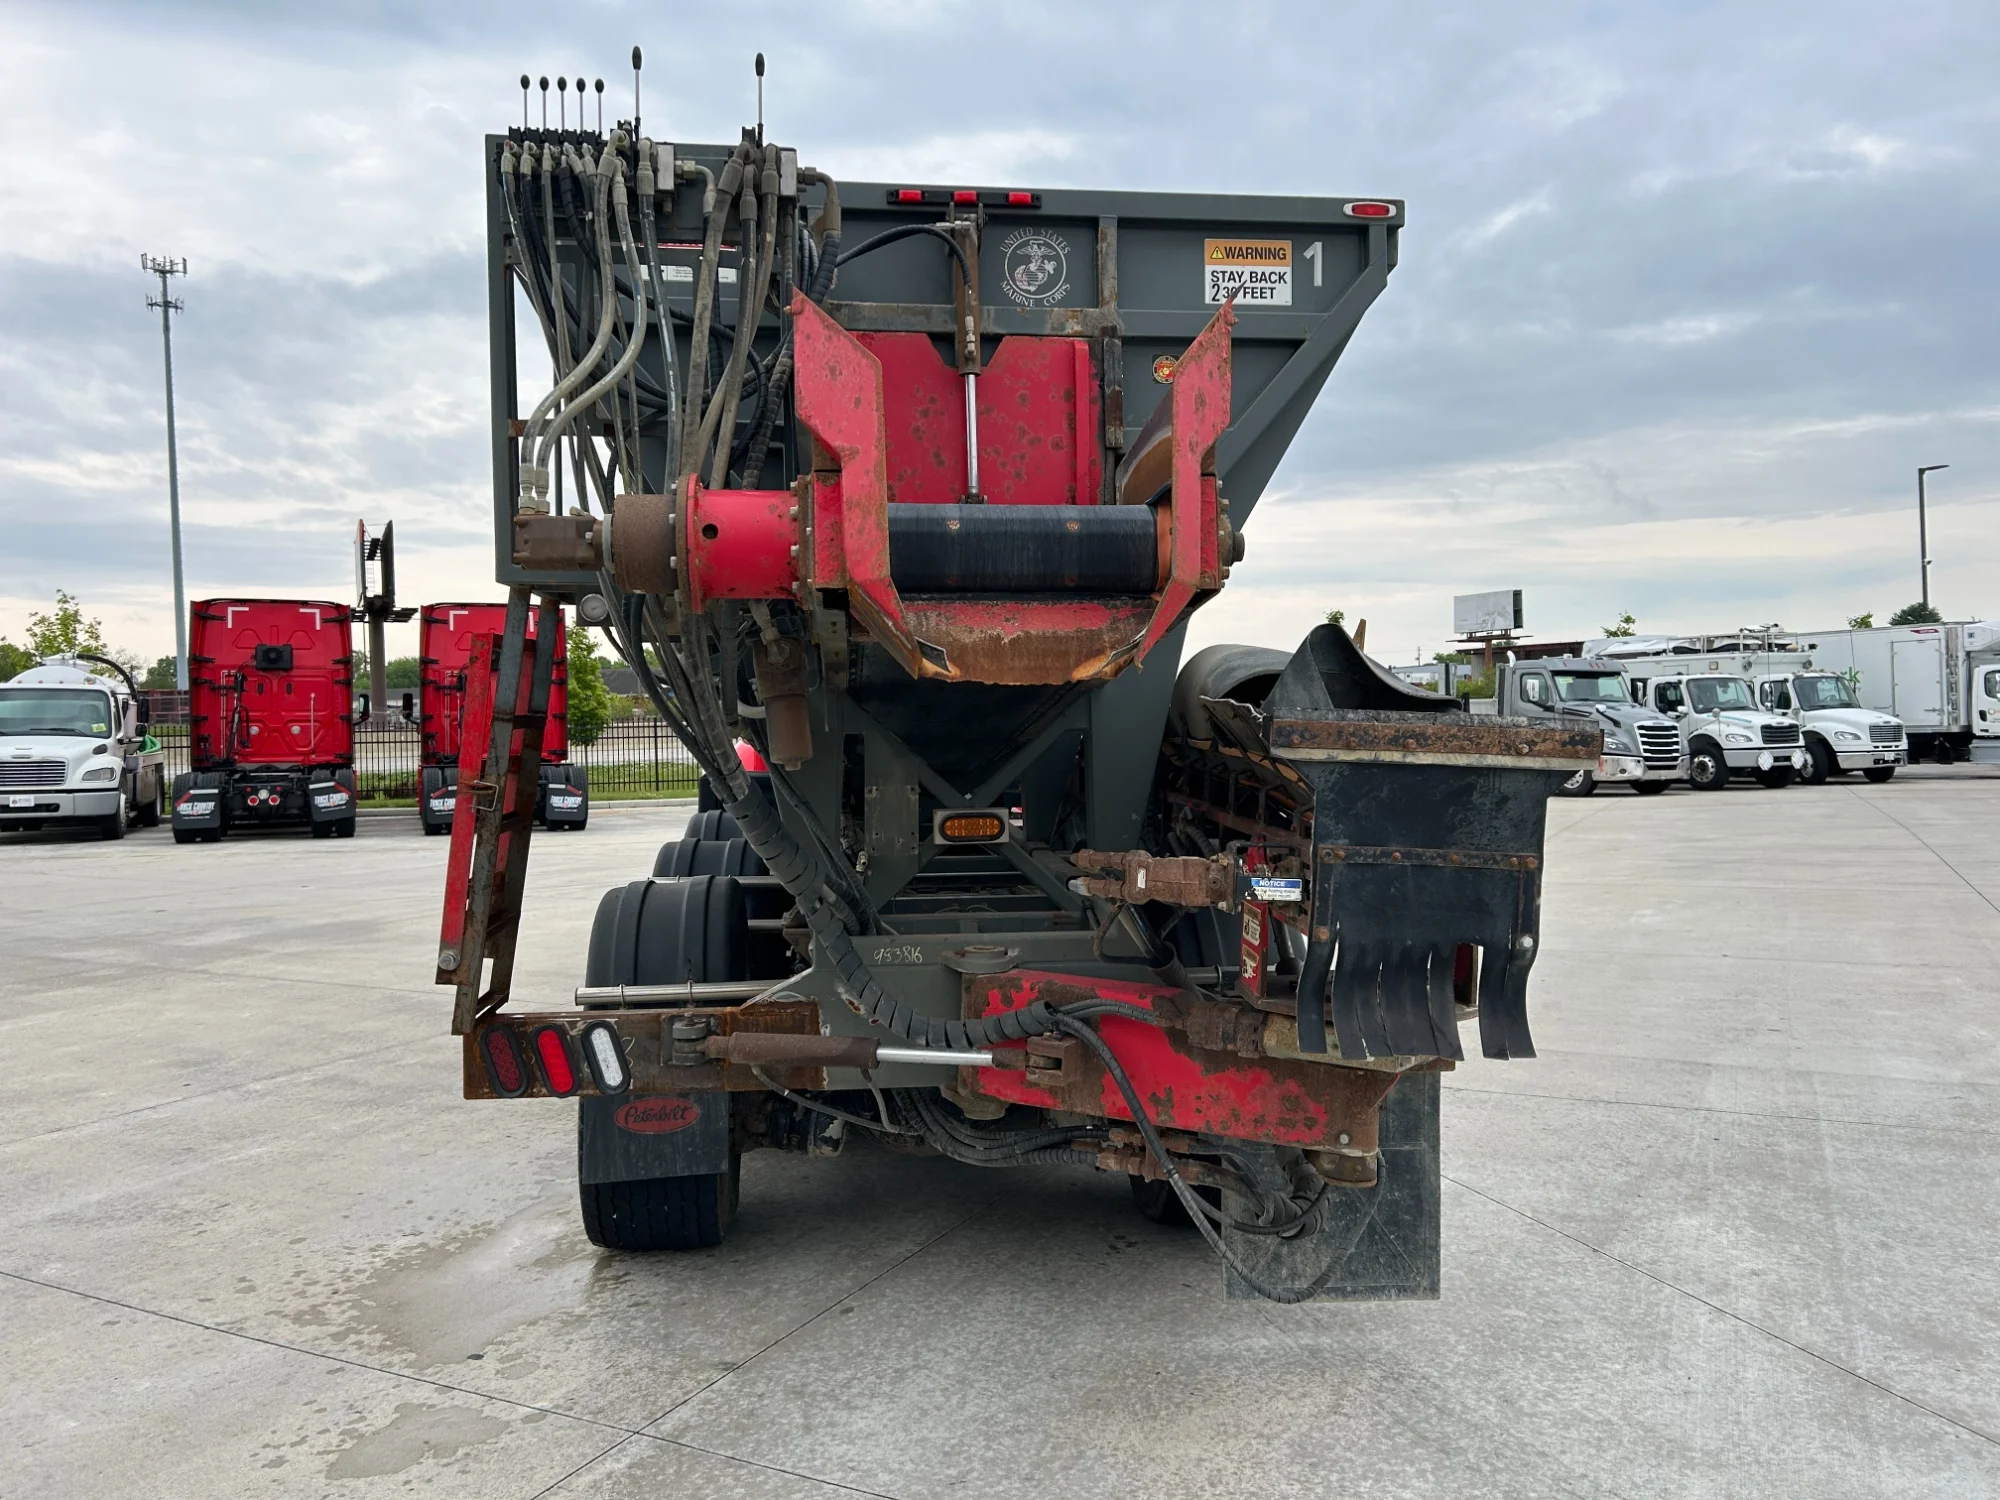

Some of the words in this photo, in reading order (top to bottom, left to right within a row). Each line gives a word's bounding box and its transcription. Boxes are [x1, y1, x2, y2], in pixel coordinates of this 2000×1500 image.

[1000, 226, 1034, 252] UNITED
[1040, 227, 1072, 254] STATES
[1224, 246, 1287, 260] WARNING
[1303, 241, 1323, 287] 1
[1210, 270, 1245, 283] STAY
[1249, 271, 1288, 284] BACK
[1000, 280, 1036, 307] MARINE
[1043, 282, 1071, 306] CORPS
[1243, 286, 1277, 299] FEET
[624, 1104, 693, 1126] Peterbilt
